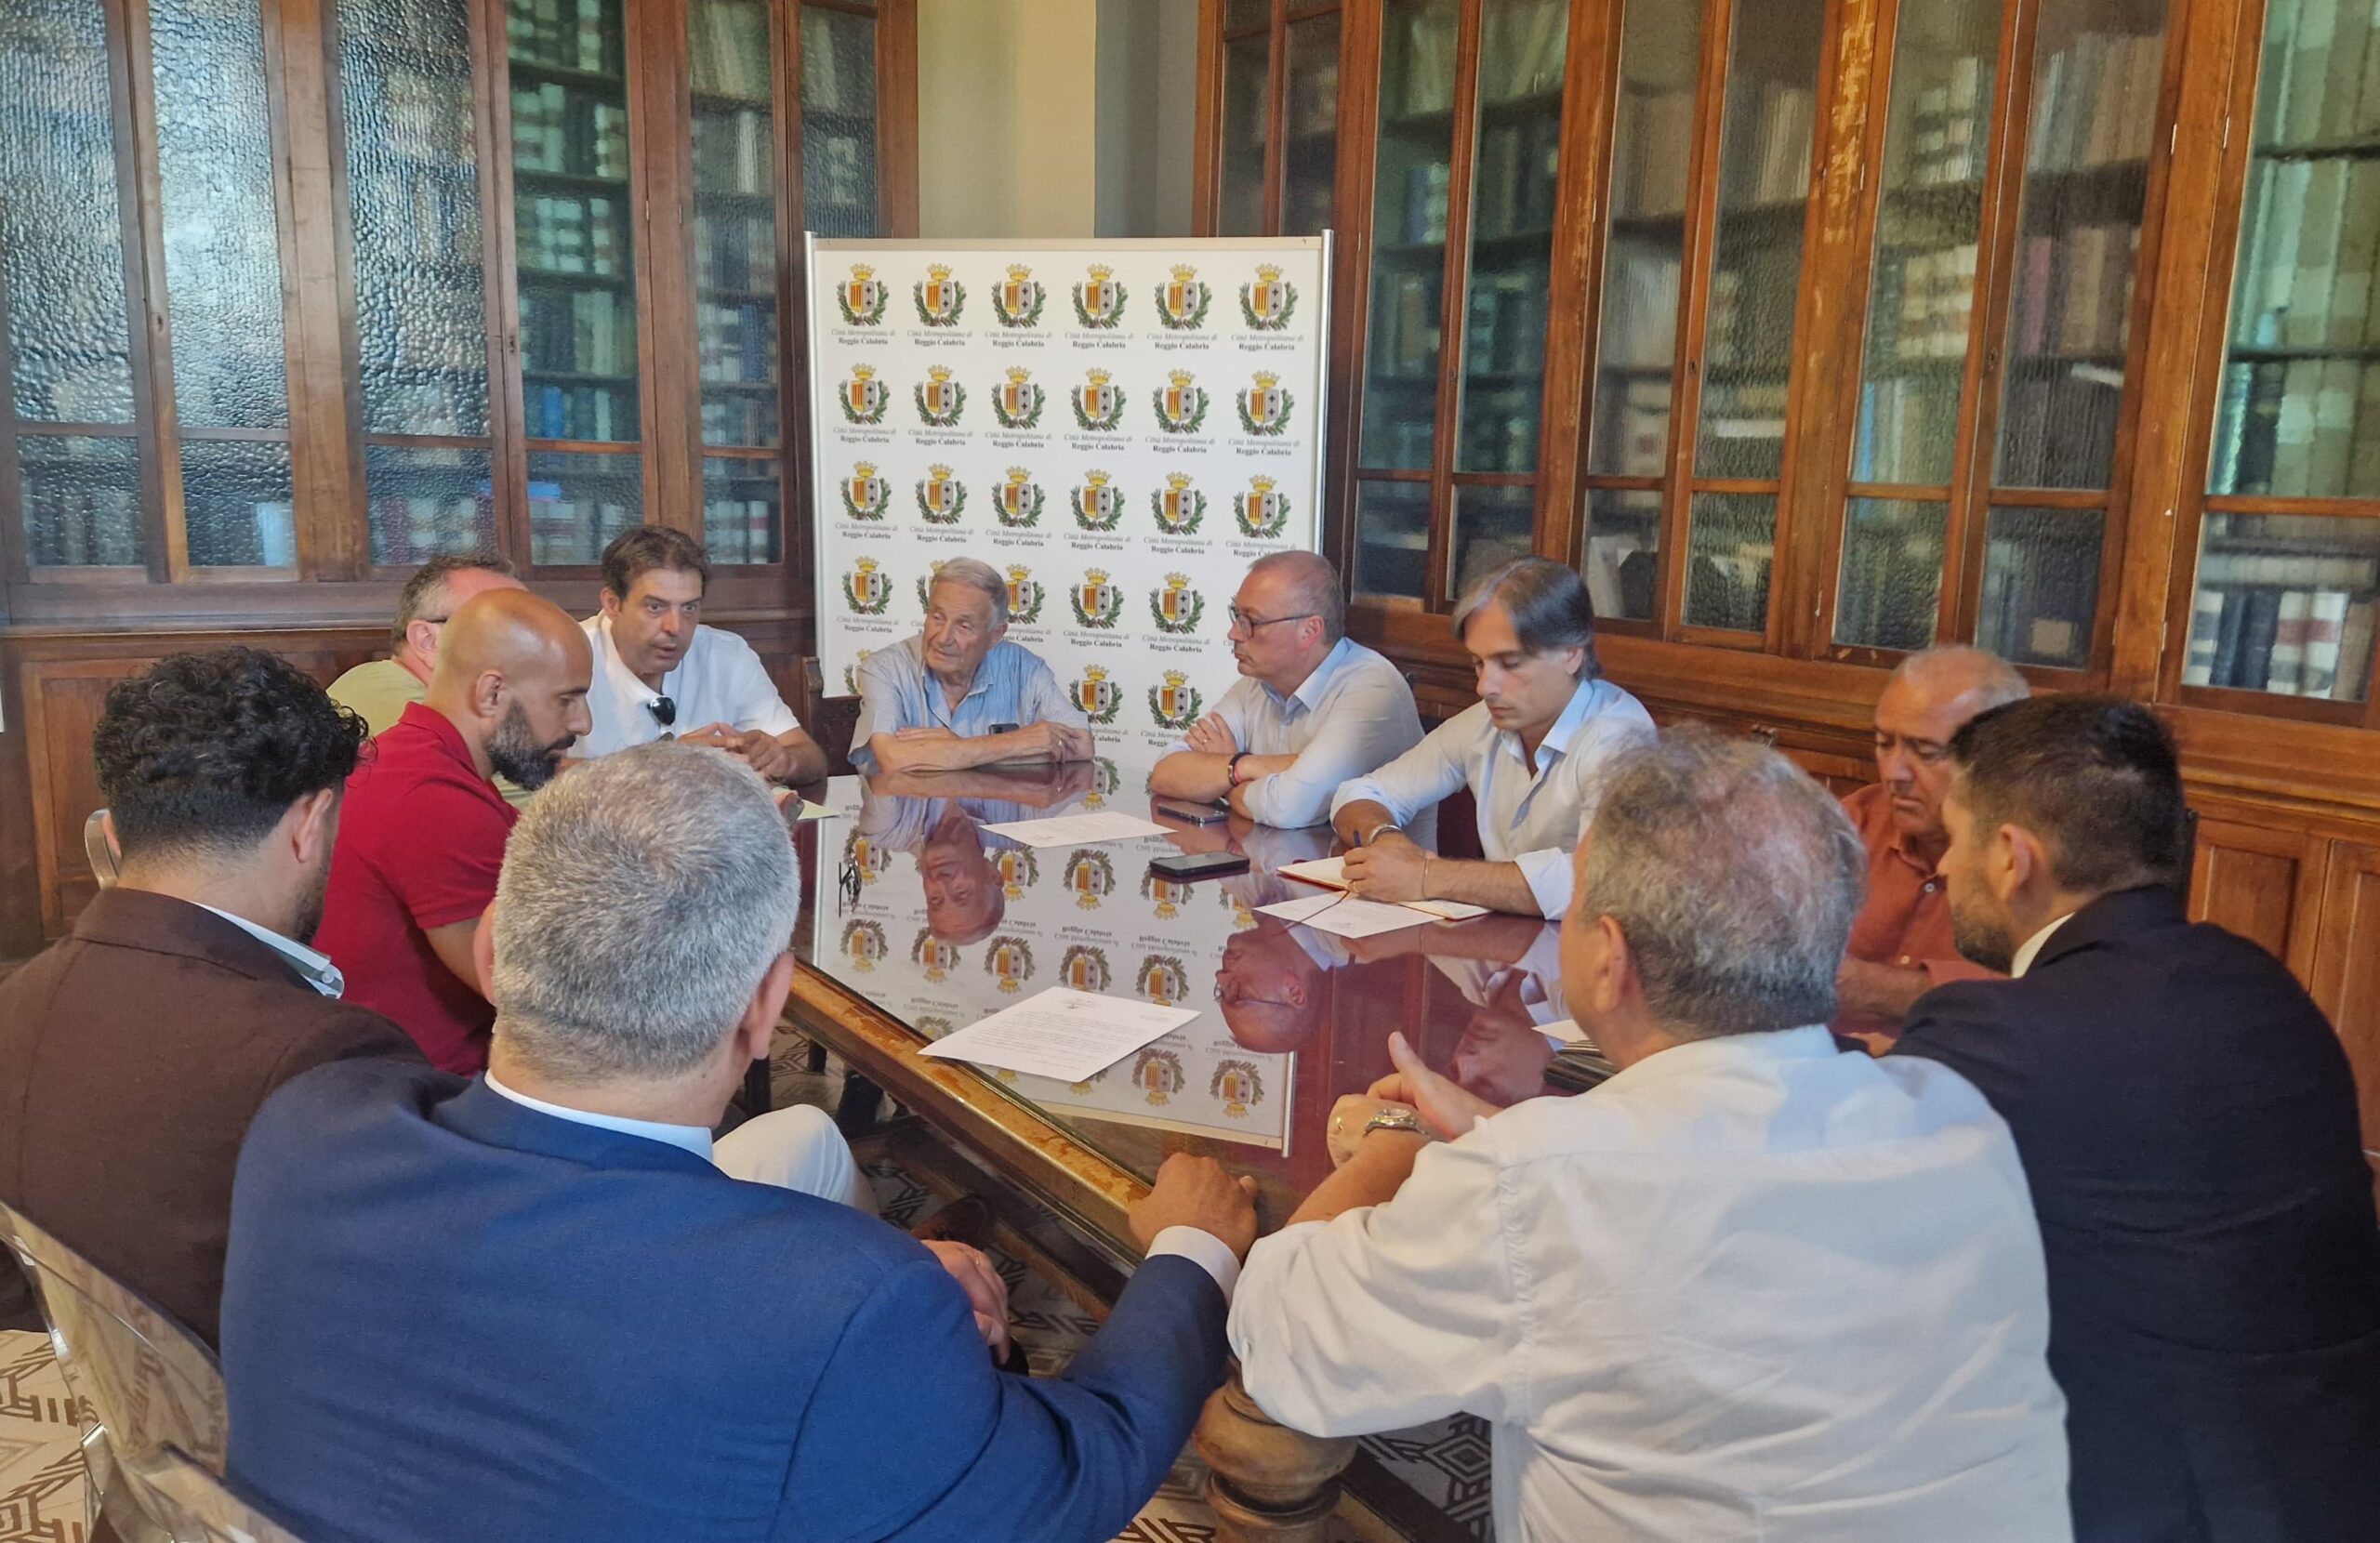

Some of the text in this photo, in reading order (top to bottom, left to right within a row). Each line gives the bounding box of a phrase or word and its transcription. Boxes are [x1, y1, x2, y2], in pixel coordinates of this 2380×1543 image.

[847, 329, 889, 338] Metropolitana
[923, 330, 966, 339] Metropolitana
[1001, 331, 1045, 340] Metropolitana
[1082, 332, 1127, 341] Metropolitana
[1164, 333, 1210, 342] Metropolitana
[839, 337, 860, 346] Reggio
[915, 338, 936, 347] Reggio
[993, 339, 1014, 348] Reggio
[1249, 334, 1296, 344] Metropolitana
[1073, 341, 1095, 349] Reggio
[1155, 342, 1178, 350] Reggio
[1239, 343, 1263, 351] Reggio
[849, 428, 890, 437] Metropolitana
[924, 429, 966, 439] Metropolitana
[1001, 432, 1044, 442] Metropolitana
[840, 435, 861, 443] Reggio
[916, 438, 937, 446] Reggio
[1081, 434, 1125, 443] Metropolitana
[1162, 437, 1208, 446] Metropolitana
[993, 440, 1014, 449] Reggio
[1072, 442, 1094, 451] Reggio
[1246, 439, 1292, 449] Metropolitana
[1153, 445, 1207, 454] Reggio Calabria
[1236, 447, 1260, 456] Reggio
[851, 523, 892, 533] Metropolitana
[925, 526, 967, 536] Metropolitana
[842, 531, 863, 539] Reggio
[917, 534, 938, 543] Reggio
[1001, 530, 1044, 540] Metropolitana
[1080, 534, 1124, 544] Metropolitana
[993, 537, 1014, 547] Reggio
[1071, 542, 1093, 550] Reggio
[1160, 537, 1205, 547] Metropolitana
[1243, 541, 1289, 551] Metropolitana
[1151, 546, 1174, 554] Reggio
[1234, 549, 1257, 558] Reggio
[844, 624, 865, 633] Reggio
[1015, 635, 1043, 643] Calabria
[1071, 639, 1122, 648] Reggio Calabria
[1150, 643, 1172, 653] Reggio
